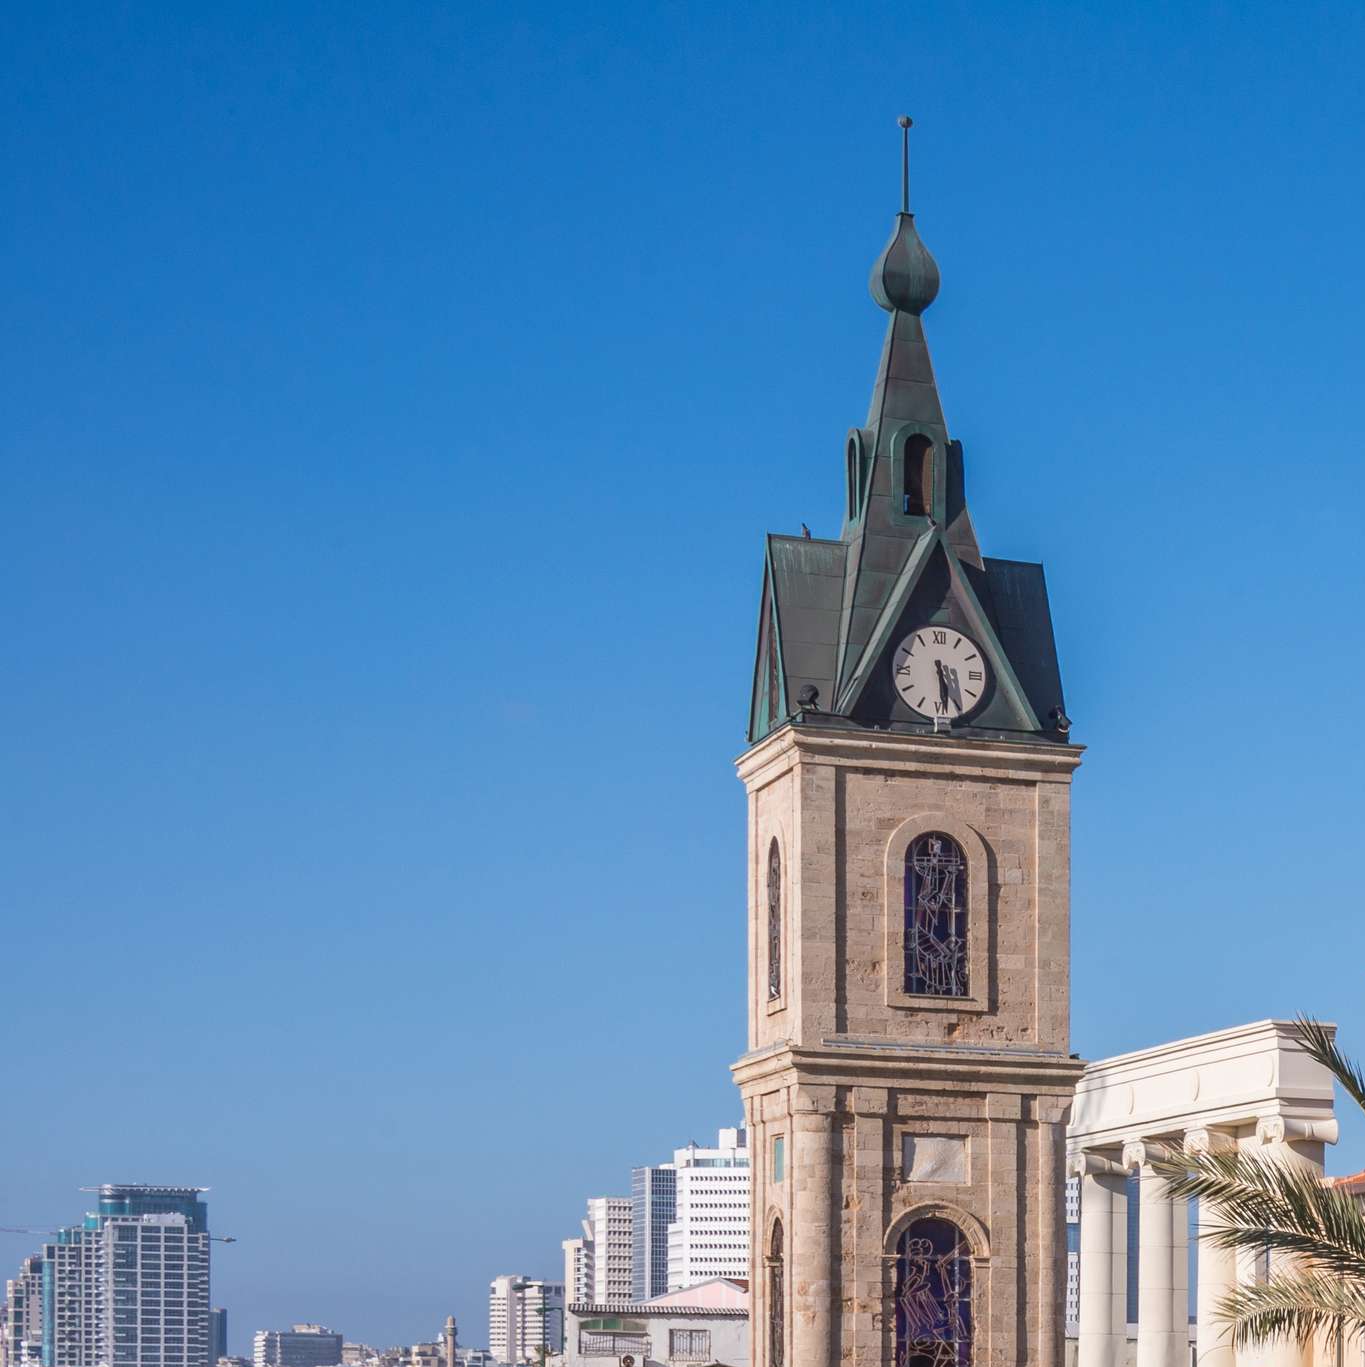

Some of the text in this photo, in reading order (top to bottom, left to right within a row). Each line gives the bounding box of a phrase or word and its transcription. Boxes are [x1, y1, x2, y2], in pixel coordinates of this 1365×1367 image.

[932, 631, 946, 645] XII
[896, 664, 911, 676] IX
[968, 670, 982, 681] III
